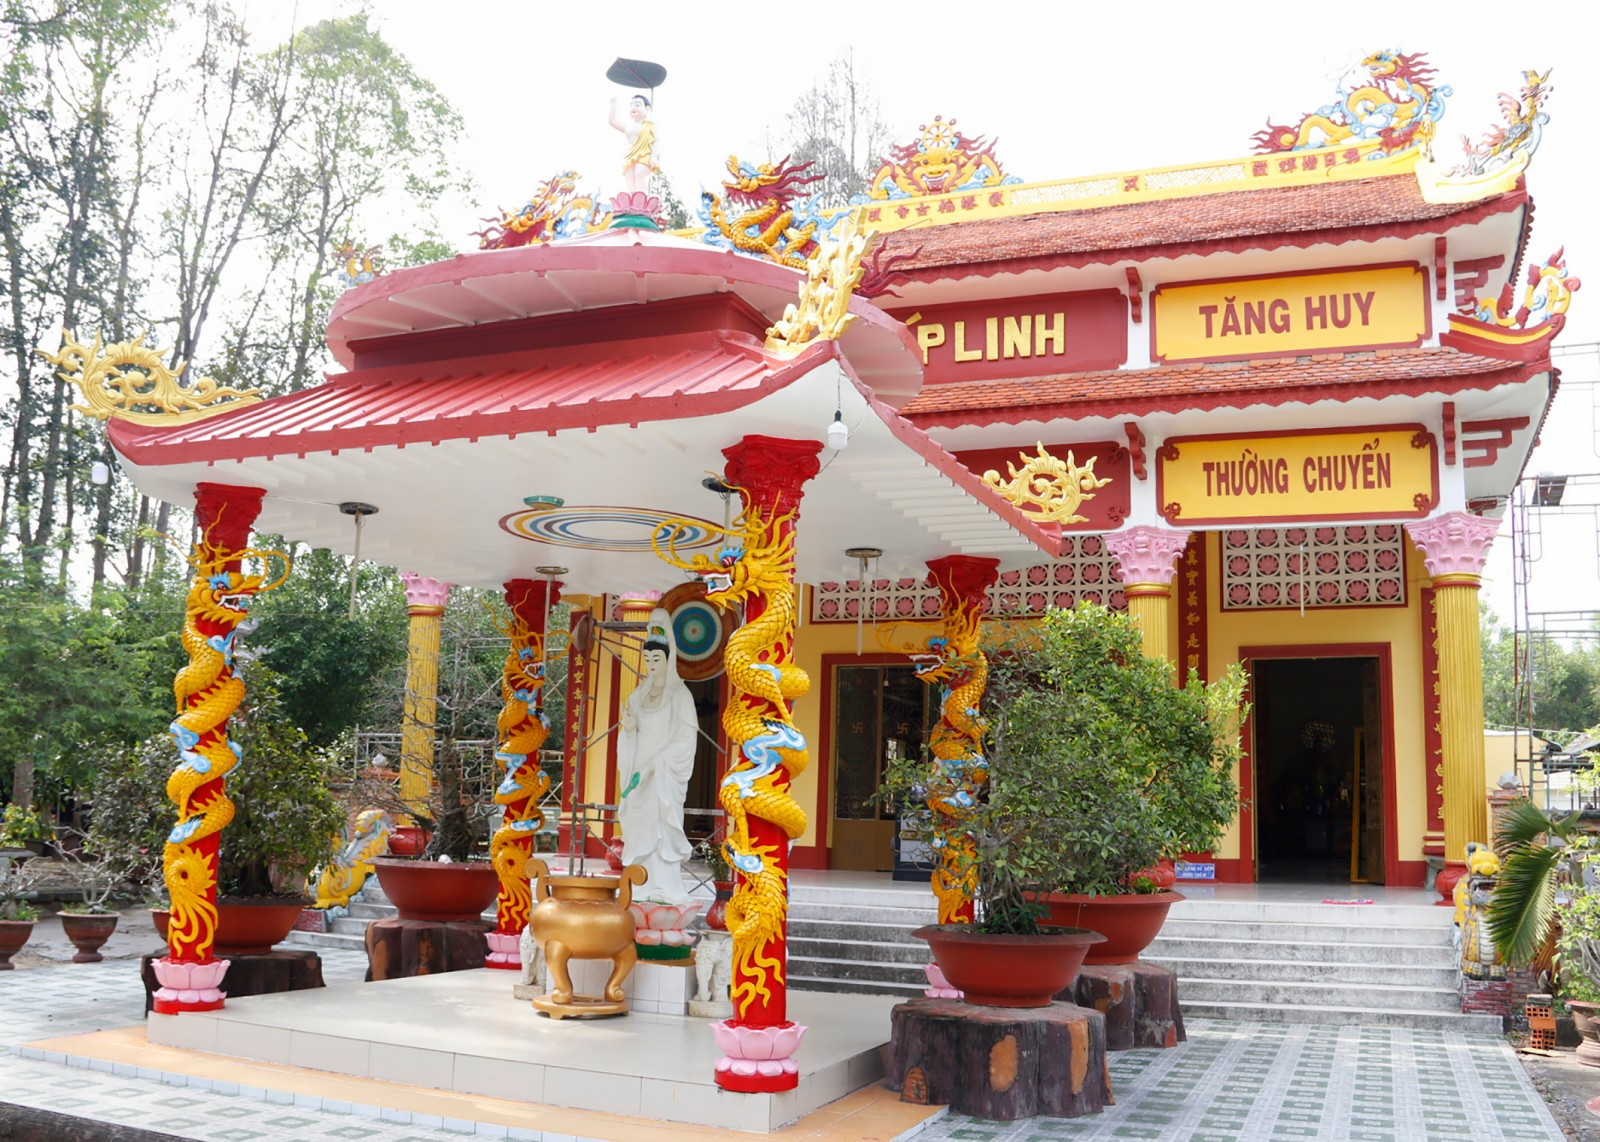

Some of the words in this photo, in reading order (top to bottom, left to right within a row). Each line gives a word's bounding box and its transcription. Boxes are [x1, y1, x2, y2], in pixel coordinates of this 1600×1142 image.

[954, 312, 1065, 362] LINH
[1199, 295, 1291, 338] TĂNG
[1305, 291, 1375, 331] HUY
[1202, 448, 1289, 497] THƯỜNG
[1302, 437, 1391, 493] CHUYỂN
